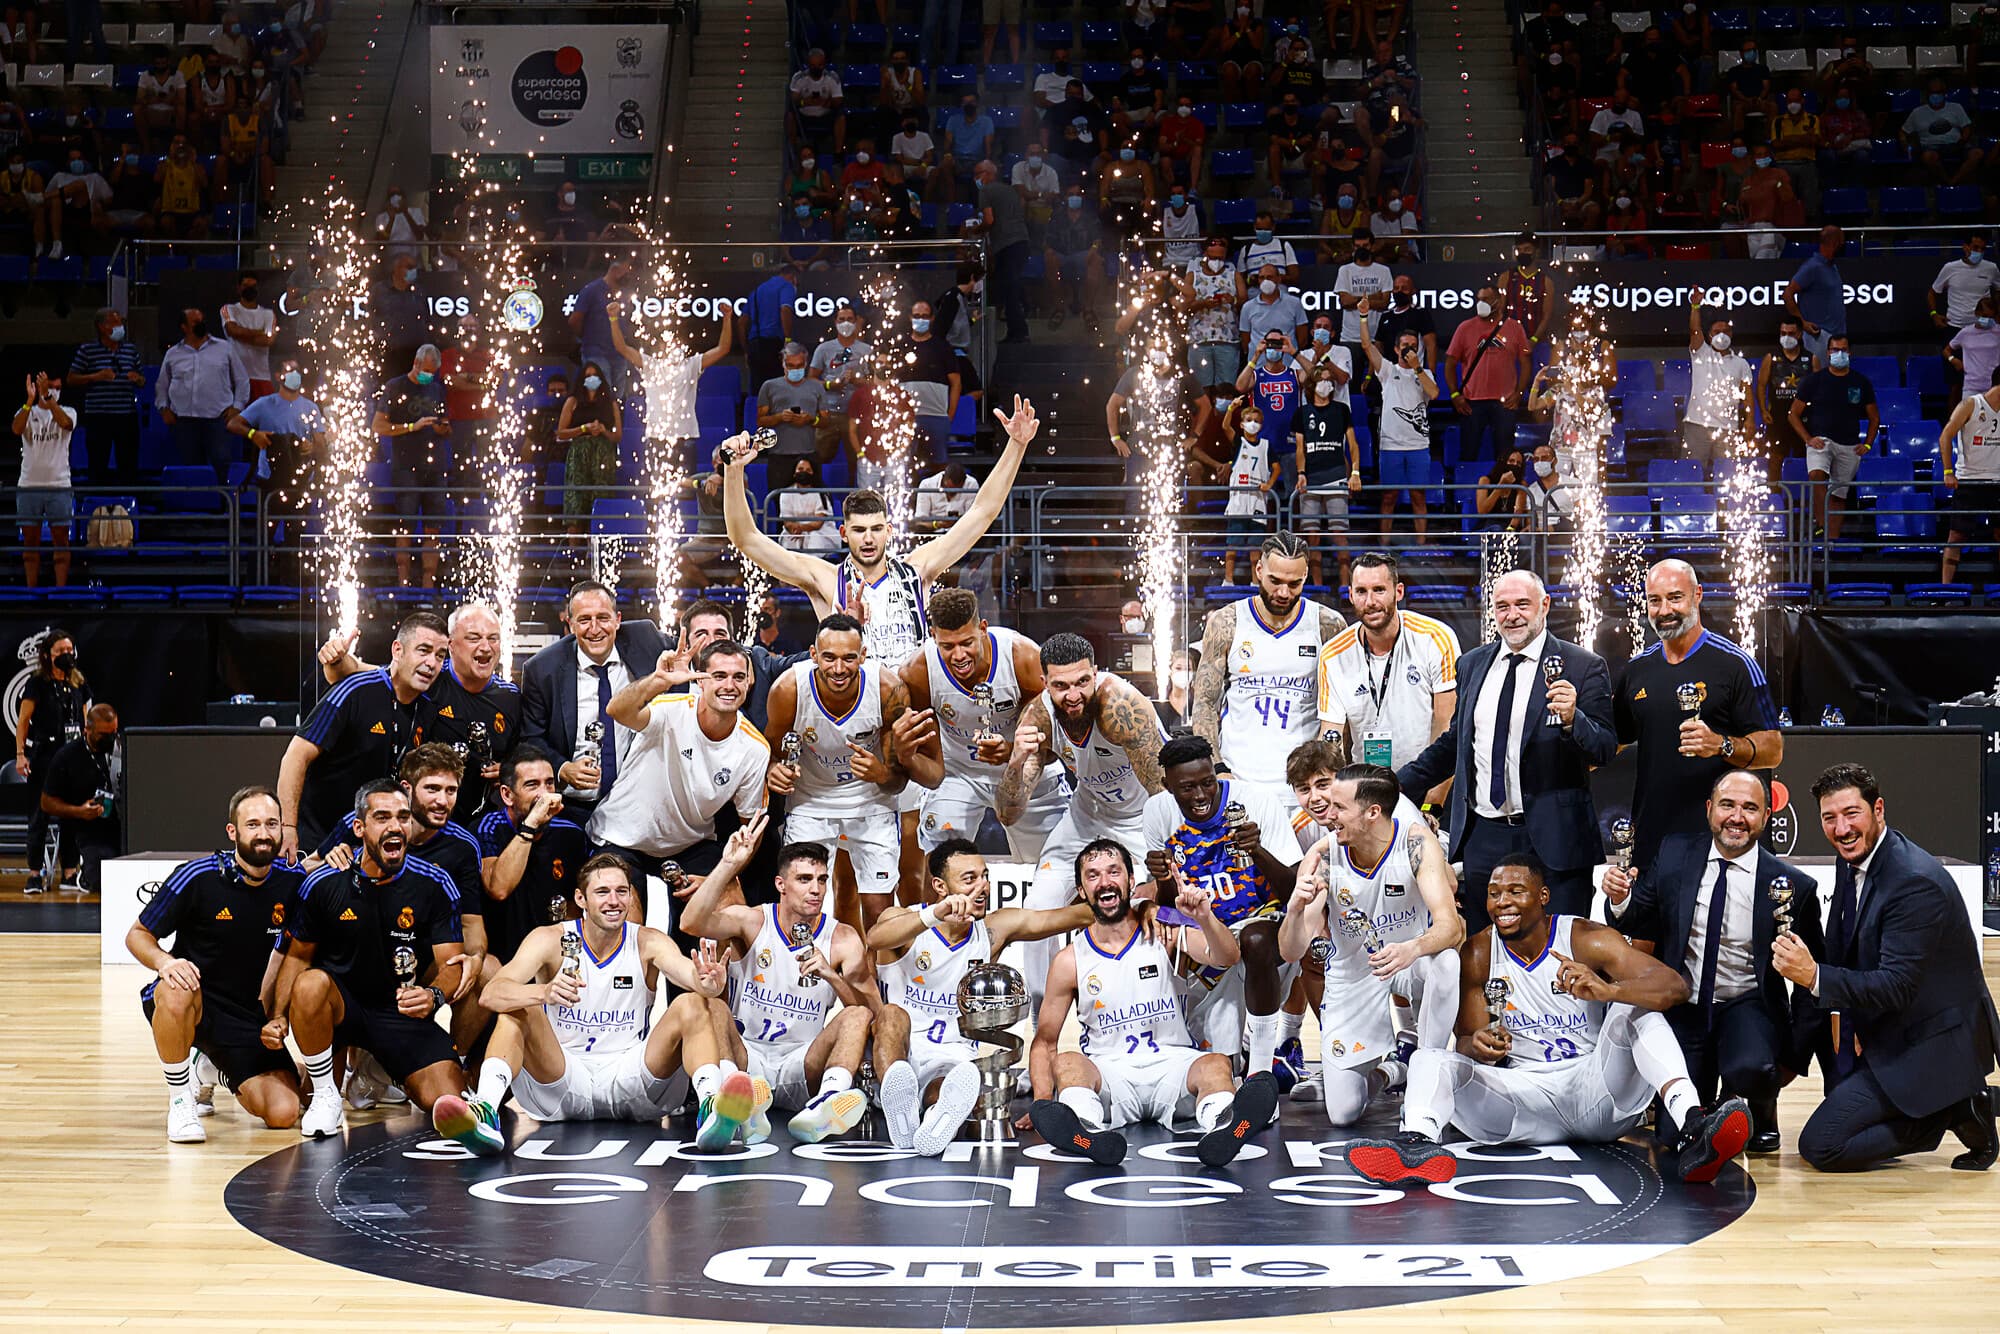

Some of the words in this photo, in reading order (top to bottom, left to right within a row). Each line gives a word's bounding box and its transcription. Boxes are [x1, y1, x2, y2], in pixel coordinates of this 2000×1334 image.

[517, 78, 581, 88] supercopa
[523, 88, 581, 101] endesa
[588, 162, 625, 176] EXIT
[1260, 381, 1294, 396] NETS
[1270, 394, 1285, 412] 3
[1318, 421, 1327, 437] 9
[1991, 418, 1998, 433] 3
[1251, 456, 1259, 471] 7
[1238, 676, 1315, 689] PALLADIUM
[1254, 696, 1291, 729] 44
[1096, 788, 1126, 802] 17
[1198, 872, 1236, 904] 30
[745, 981, 821, 1013] PALLADIUM
[905, 985, 957, 1006] PALLAD
[558, 1005, 636, 1024] PALLADIUM
[742, 997, 773, 1014] HOTEL
[782, 1010, 818, 1022] GROUP
[1097, 996, 1175, 1027] PALLADIUM
[557, 1021, 591, 1034] HOTEL
[1140, 1014, 1176, 1027] GROUP
[1505, 1011, 1588, 1029] PALLADIUM
[757, 1018, 788, 1042] 12
[926, 1019, 947, 1044] 0
[1125, 1030, 1160, 1054] 23
[468, 1166, 1624, 1208] endesa
[748, 1253, 1330, 1279] Tenerife
